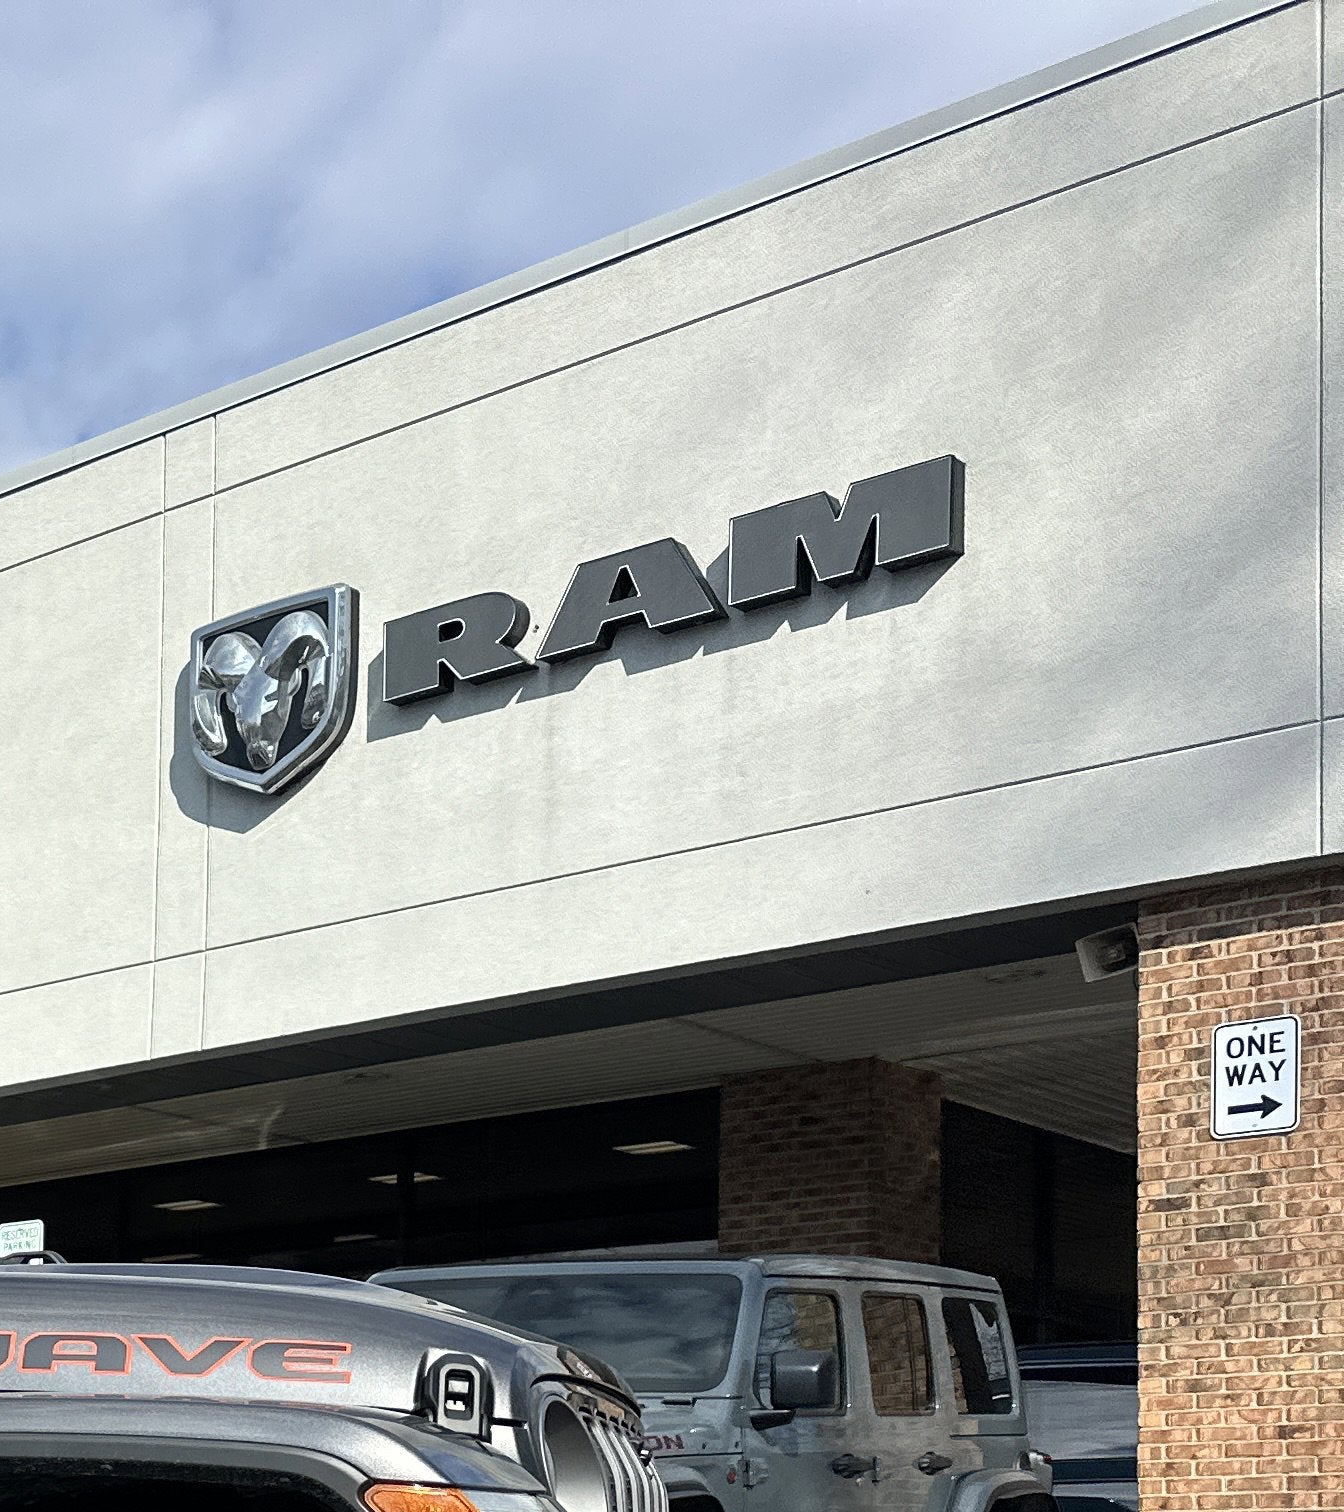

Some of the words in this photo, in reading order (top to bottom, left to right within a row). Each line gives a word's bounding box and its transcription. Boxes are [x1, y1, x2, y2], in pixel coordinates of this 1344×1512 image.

[384, 455, 965, 705] RAM
[1226, 1031, 1286, 1059] ONE
[1225, 1059, 1287, 1087] WAY
[2, 1227, 38, 1240] RESERVED
